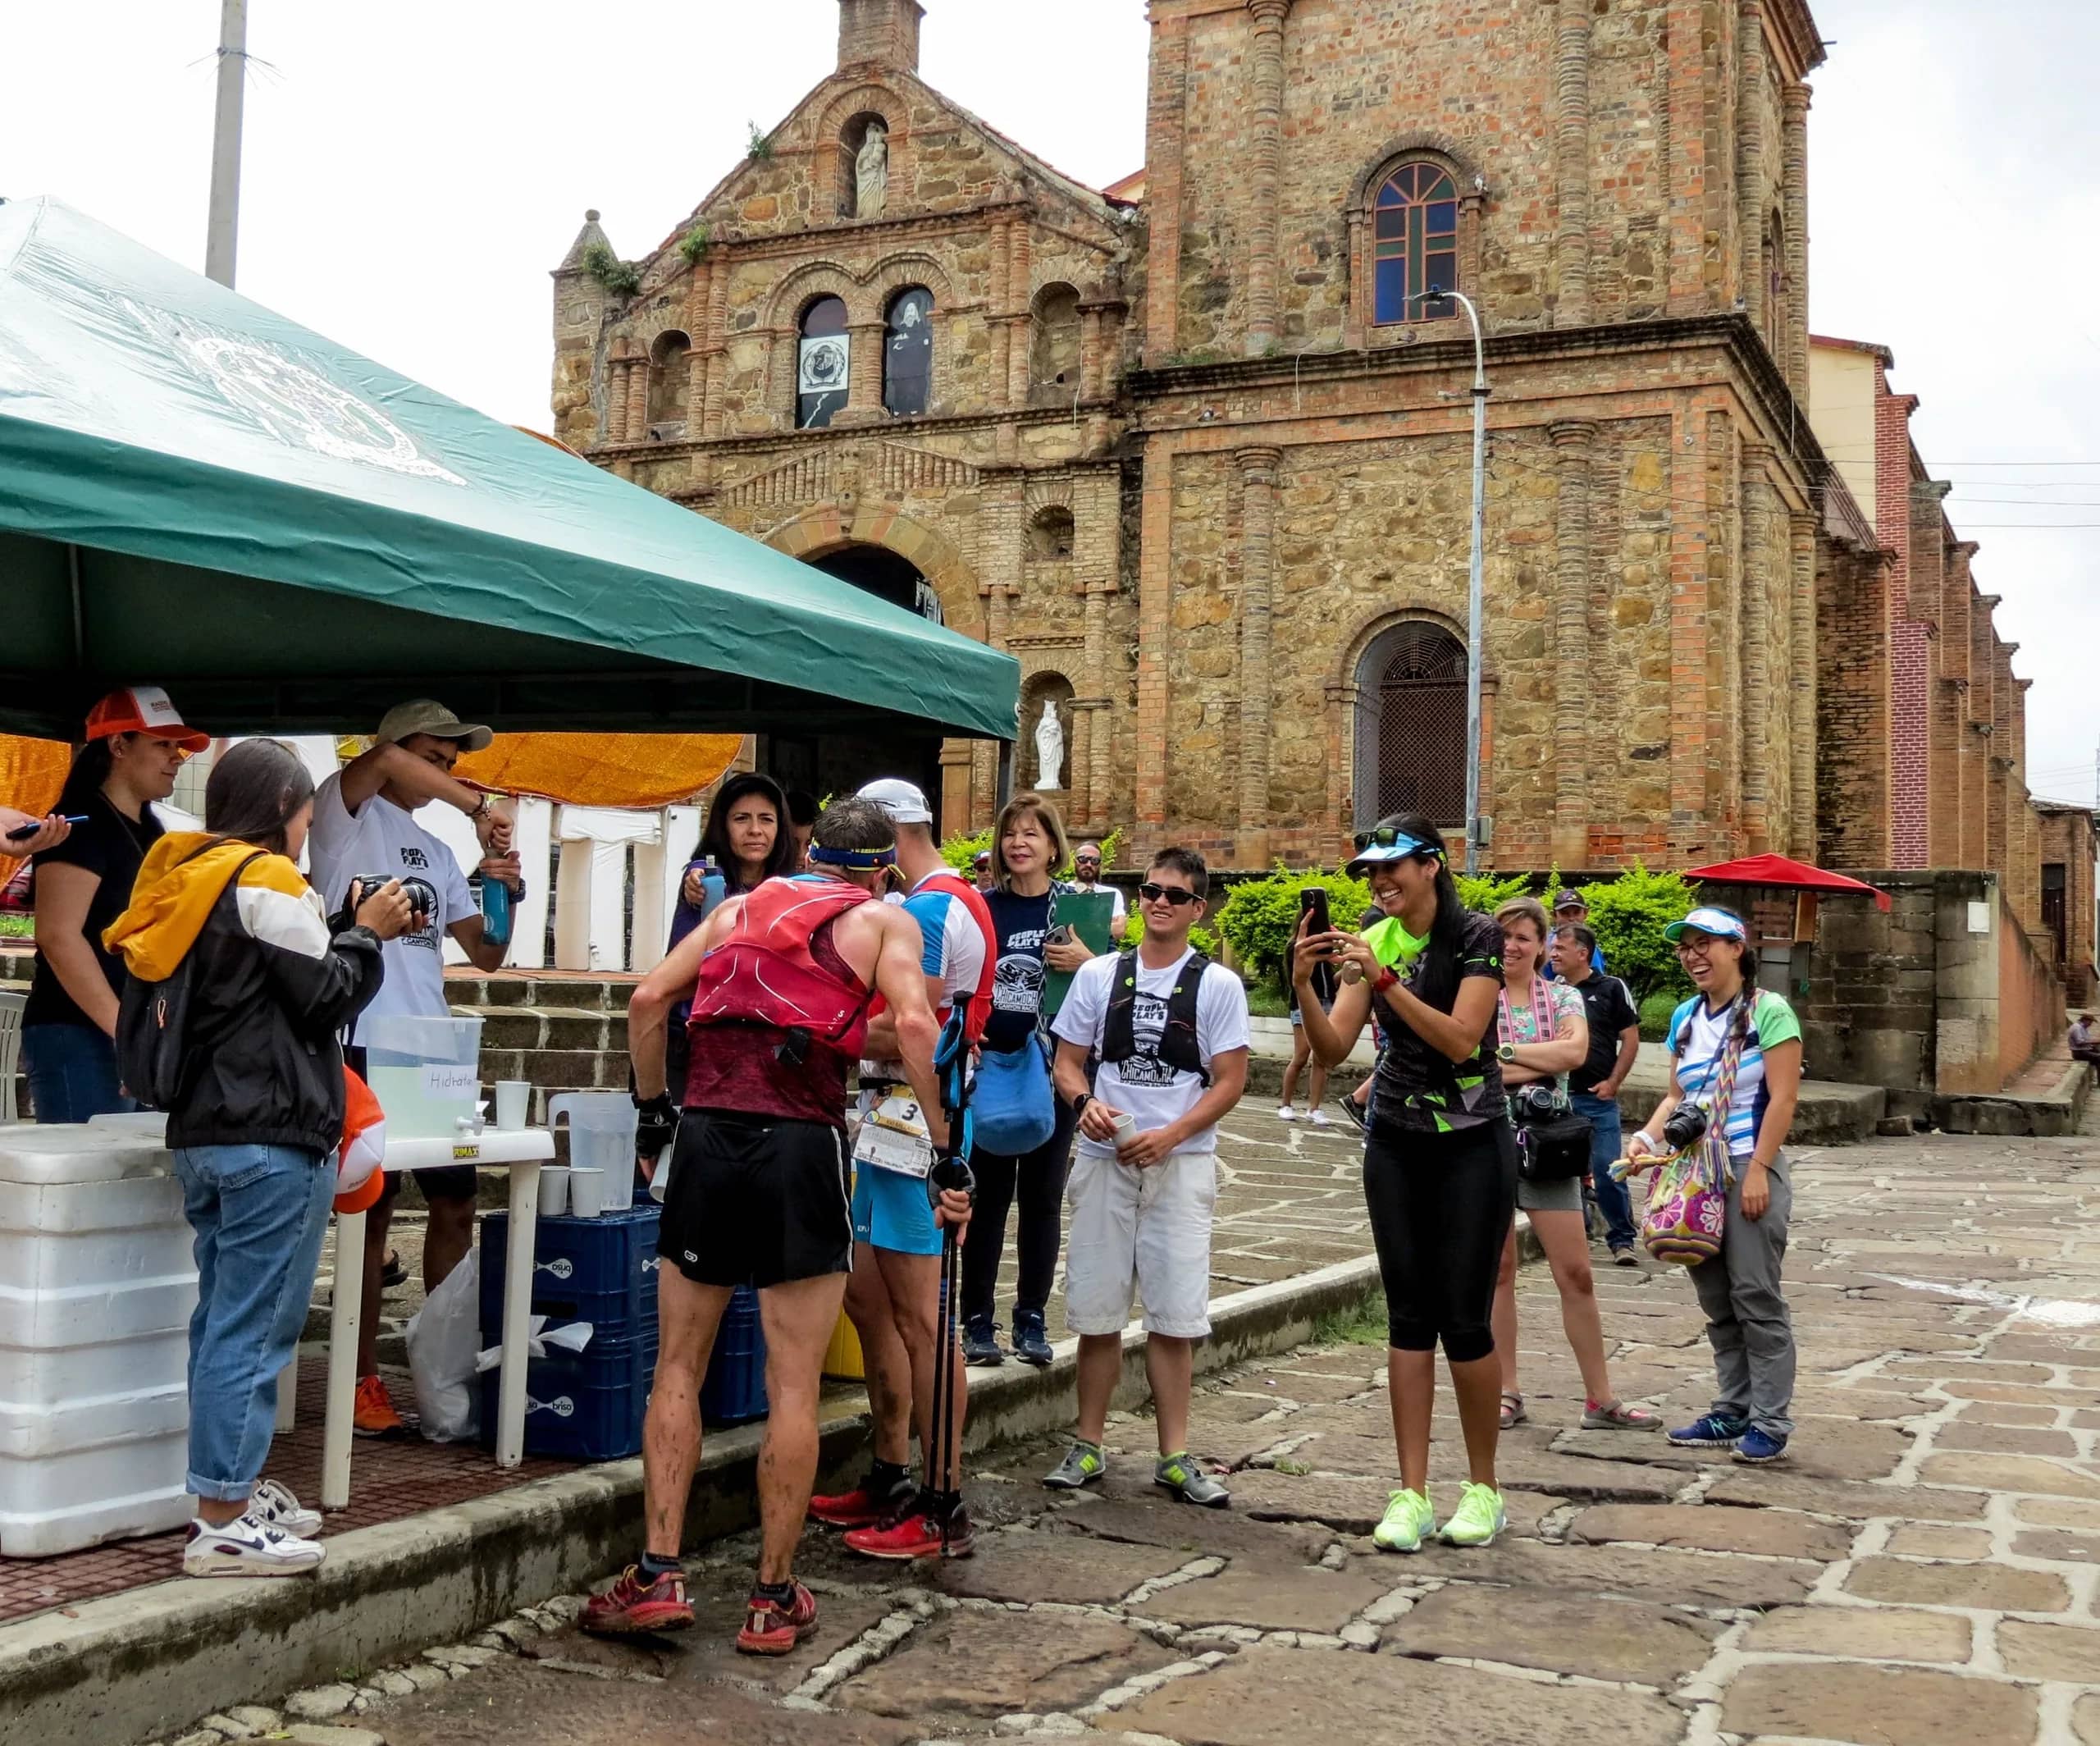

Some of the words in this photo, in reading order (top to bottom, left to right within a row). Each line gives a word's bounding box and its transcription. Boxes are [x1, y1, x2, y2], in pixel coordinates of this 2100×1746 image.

[902, 1104, 919, 1122] 3
[551, 1264, 571, 1274] brisa
[552, 1400, 572, 1411] brisa
